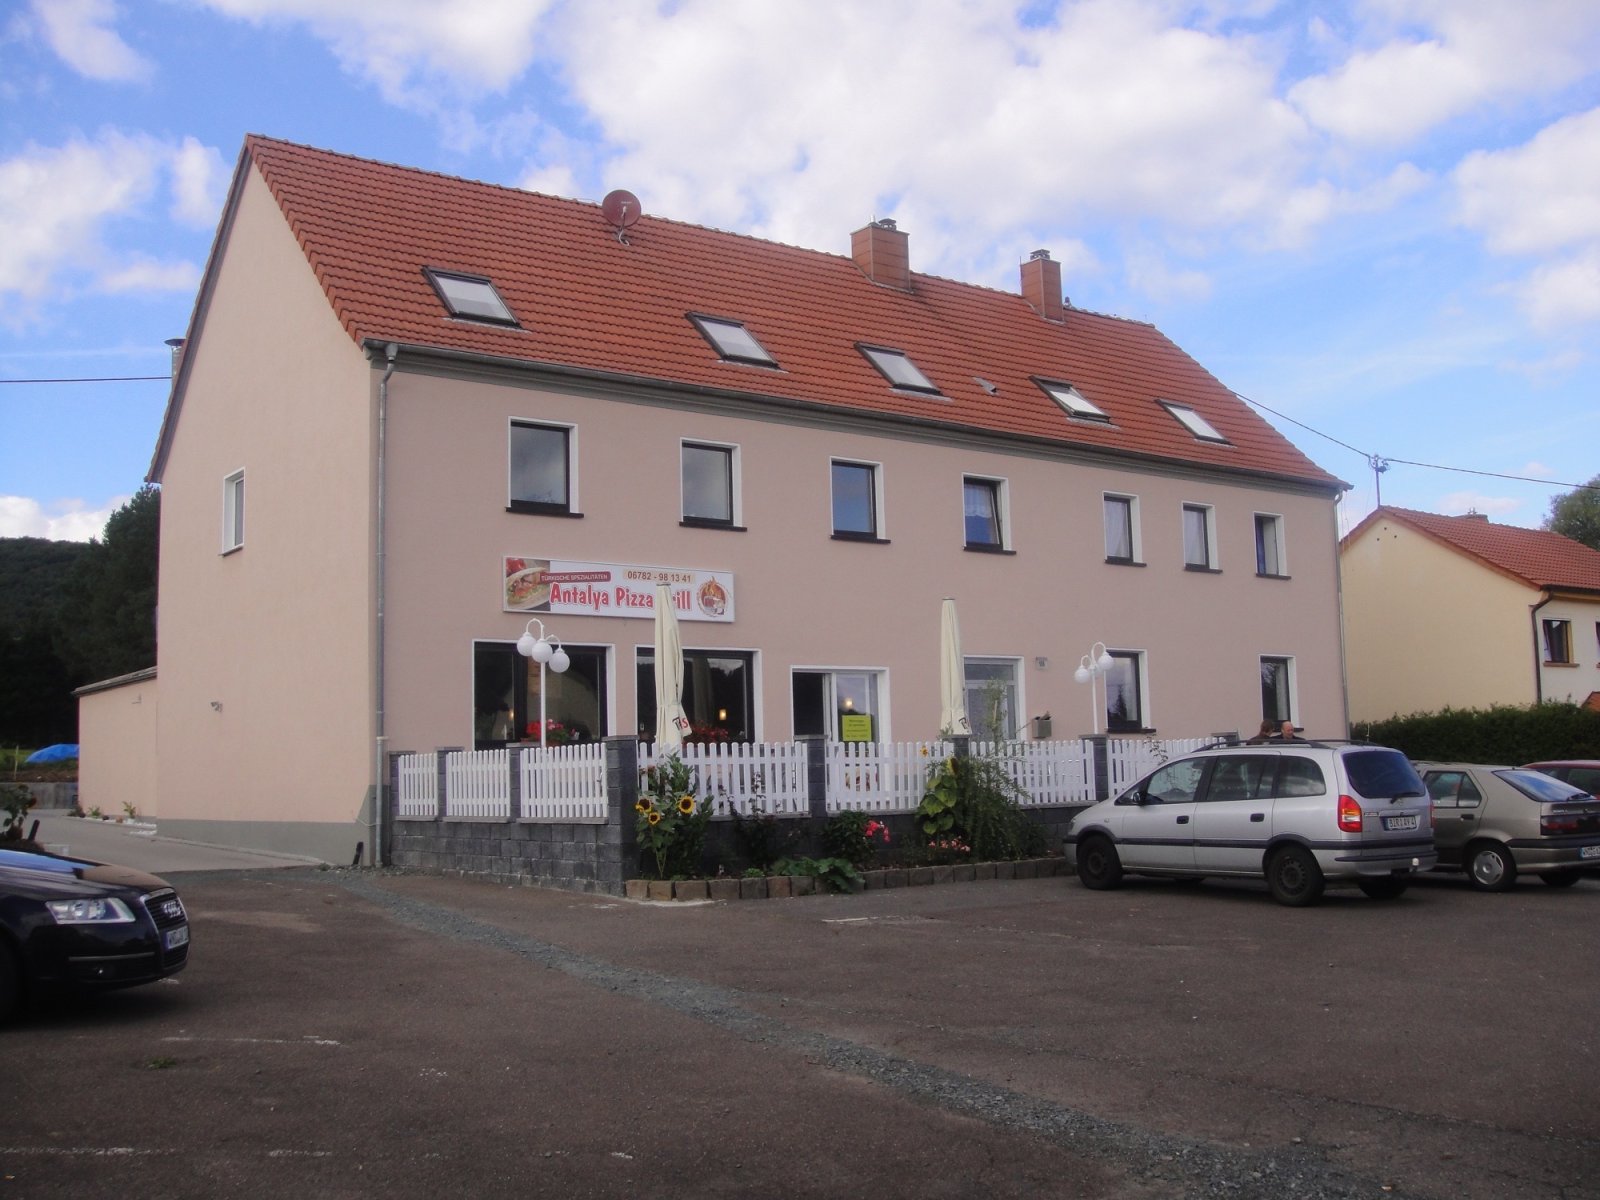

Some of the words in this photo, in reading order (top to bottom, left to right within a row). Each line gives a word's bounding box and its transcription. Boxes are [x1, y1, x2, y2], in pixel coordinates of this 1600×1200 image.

[627, 571, 652, 580] 06782
[659, 573, 668, 581] 98
[671, 574, 680, 582] 13
[682, 575, 691, 583] 41
[550, 583, 609, 610] Antalya
[615, 587, 653, 608] Pizza
[672, 590, 691, 609] ill
